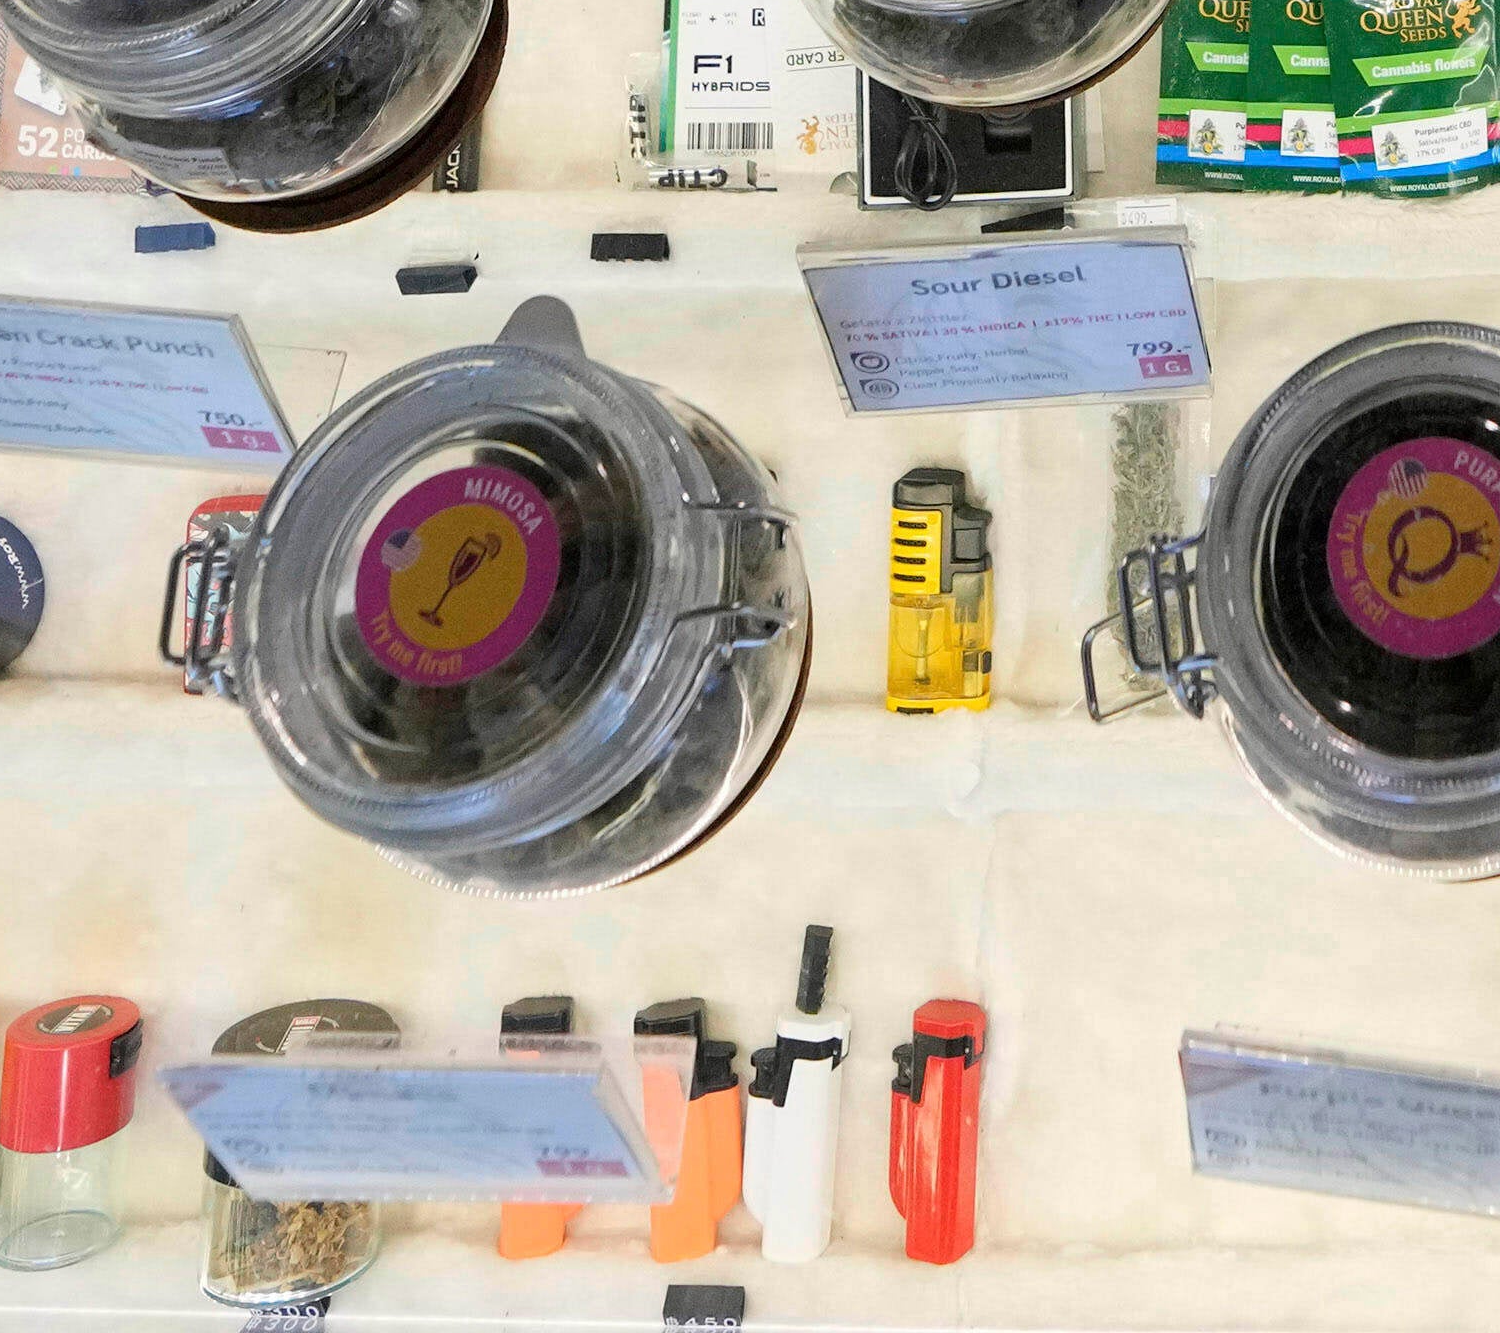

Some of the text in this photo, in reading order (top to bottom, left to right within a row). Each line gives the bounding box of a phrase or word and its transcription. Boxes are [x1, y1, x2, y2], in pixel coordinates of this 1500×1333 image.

[1360, 9, 1444, 34] QUEEN
[1400, 27, 1447, 43] SEEDS
[694, 55, 733, 74] F1
[786, 52, 824, 66] CARD
[1371, 55, 1476, 79] Cannabis flowers
[692, 82, 770, 92] HYBRIDS
[18, 125, 58, 158] 52
[910, 265, 1087, 297] Sour Diesel
[36, 328, 120, 352] Crack
[127, 332, 215, 359] Punch
[1126, 340, 1192, 357] 799.-
[464, 477, 543, 535] MIMOSA
